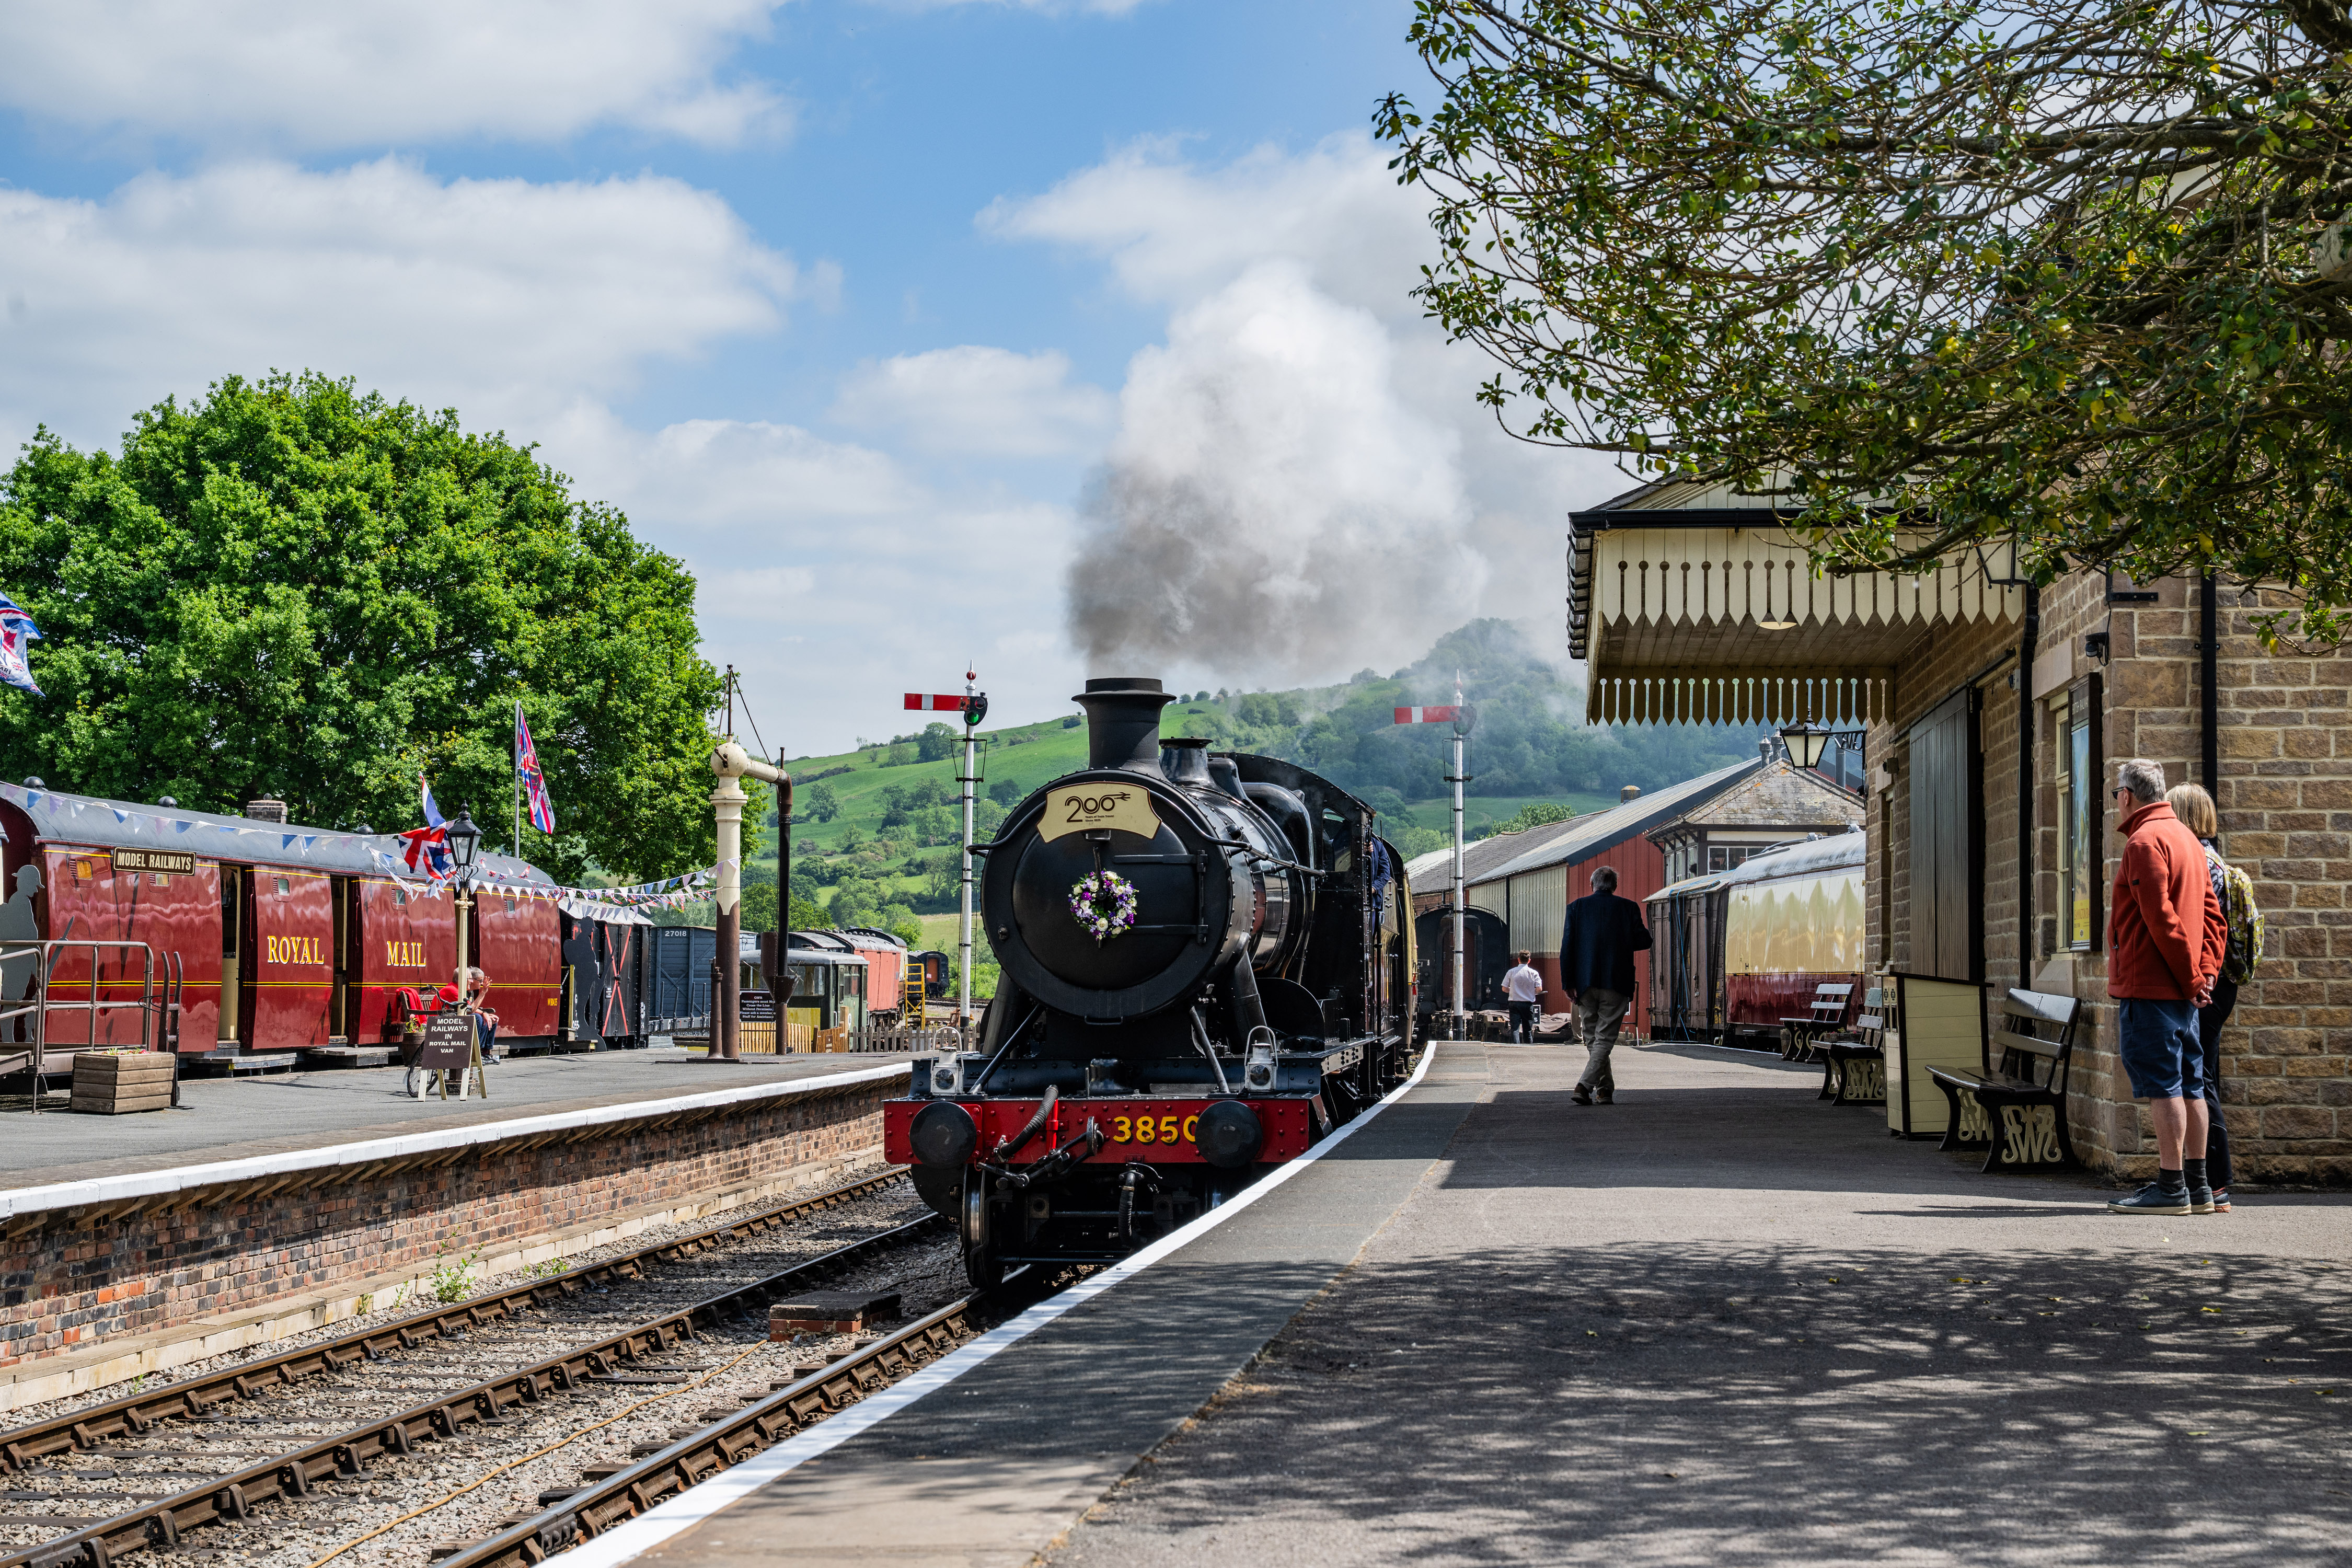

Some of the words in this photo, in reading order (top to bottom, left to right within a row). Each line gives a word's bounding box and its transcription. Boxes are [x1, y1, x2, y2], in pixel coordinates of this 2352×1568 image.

[1065, 795, 1115, 823] 200
[117, 852, 146, 867] MODEL
[149, 854, 192, 870] RAILWAYS
[267, 935, 324, 965] ROYAL
[387, 941, 426, 967] MAIL
[1112, 1115, 1200, 1143] 3850
